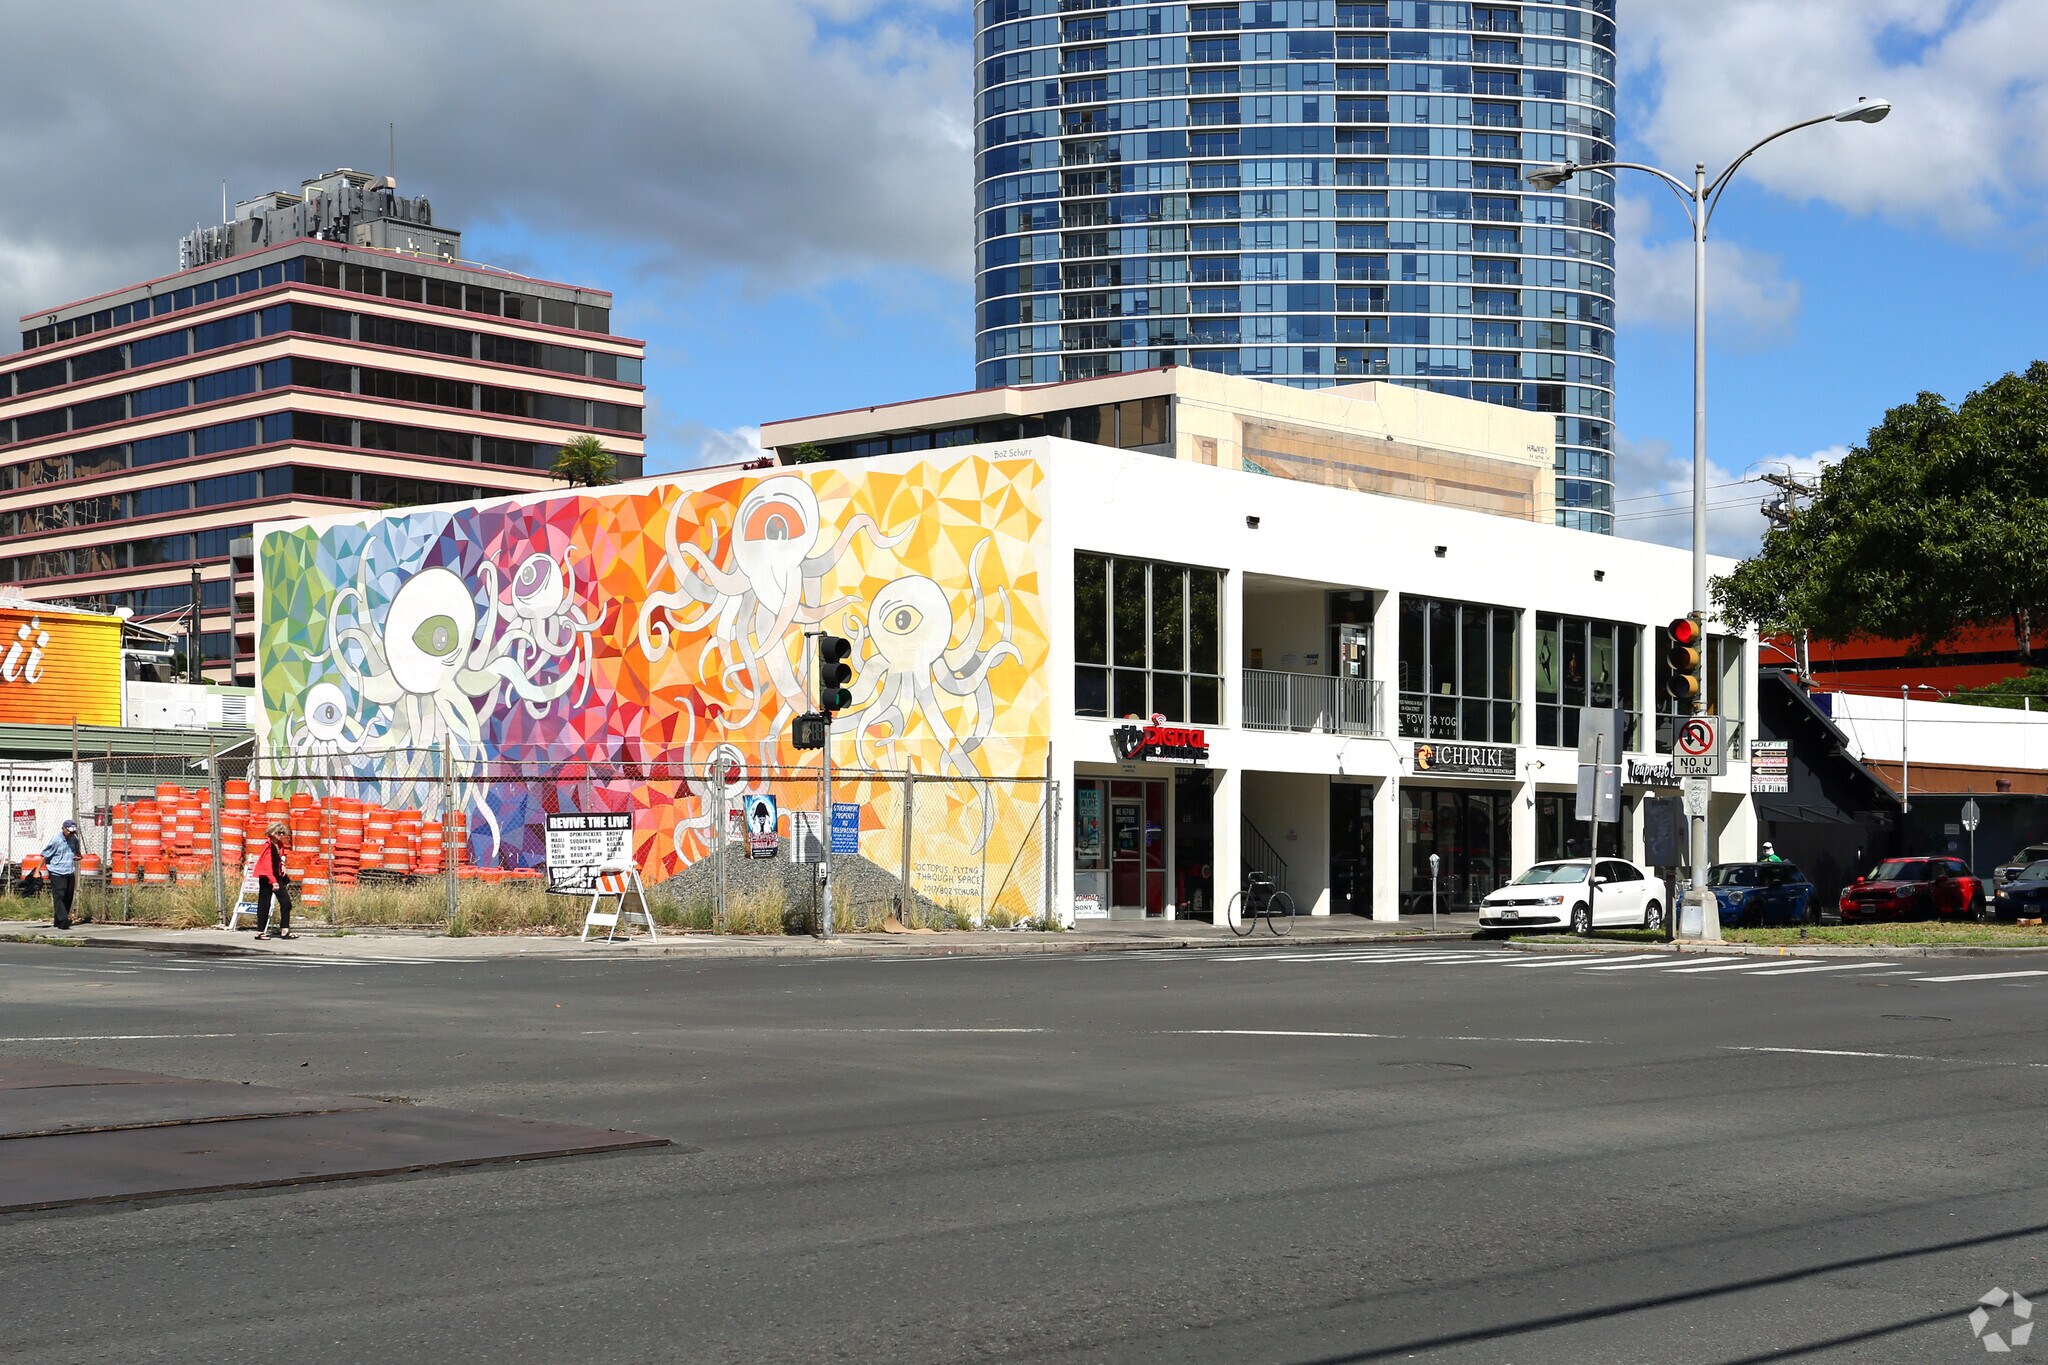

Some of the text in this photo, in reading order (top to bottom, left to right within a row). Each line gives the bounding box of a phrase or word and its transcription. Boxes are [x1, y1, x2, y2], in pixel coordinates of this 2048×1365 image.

[1440, 716, 1457, 726] YOG
[1143, 726, 1209, 748] DIGITAL
[1435, 746, 1502, 766] ICHIRIKI
[1680, 757, 1712, 767] NO U
[1630, 759, 1670, 781] Teapresso
[1080, 792, 1097, 800] MAC
[549, 815, 629, 829] REVIVE THE LIVE
[916, 864, 979, 874] OCTOPUS FLYING
[916, 873, 980, 884] THROUGH SPACE
